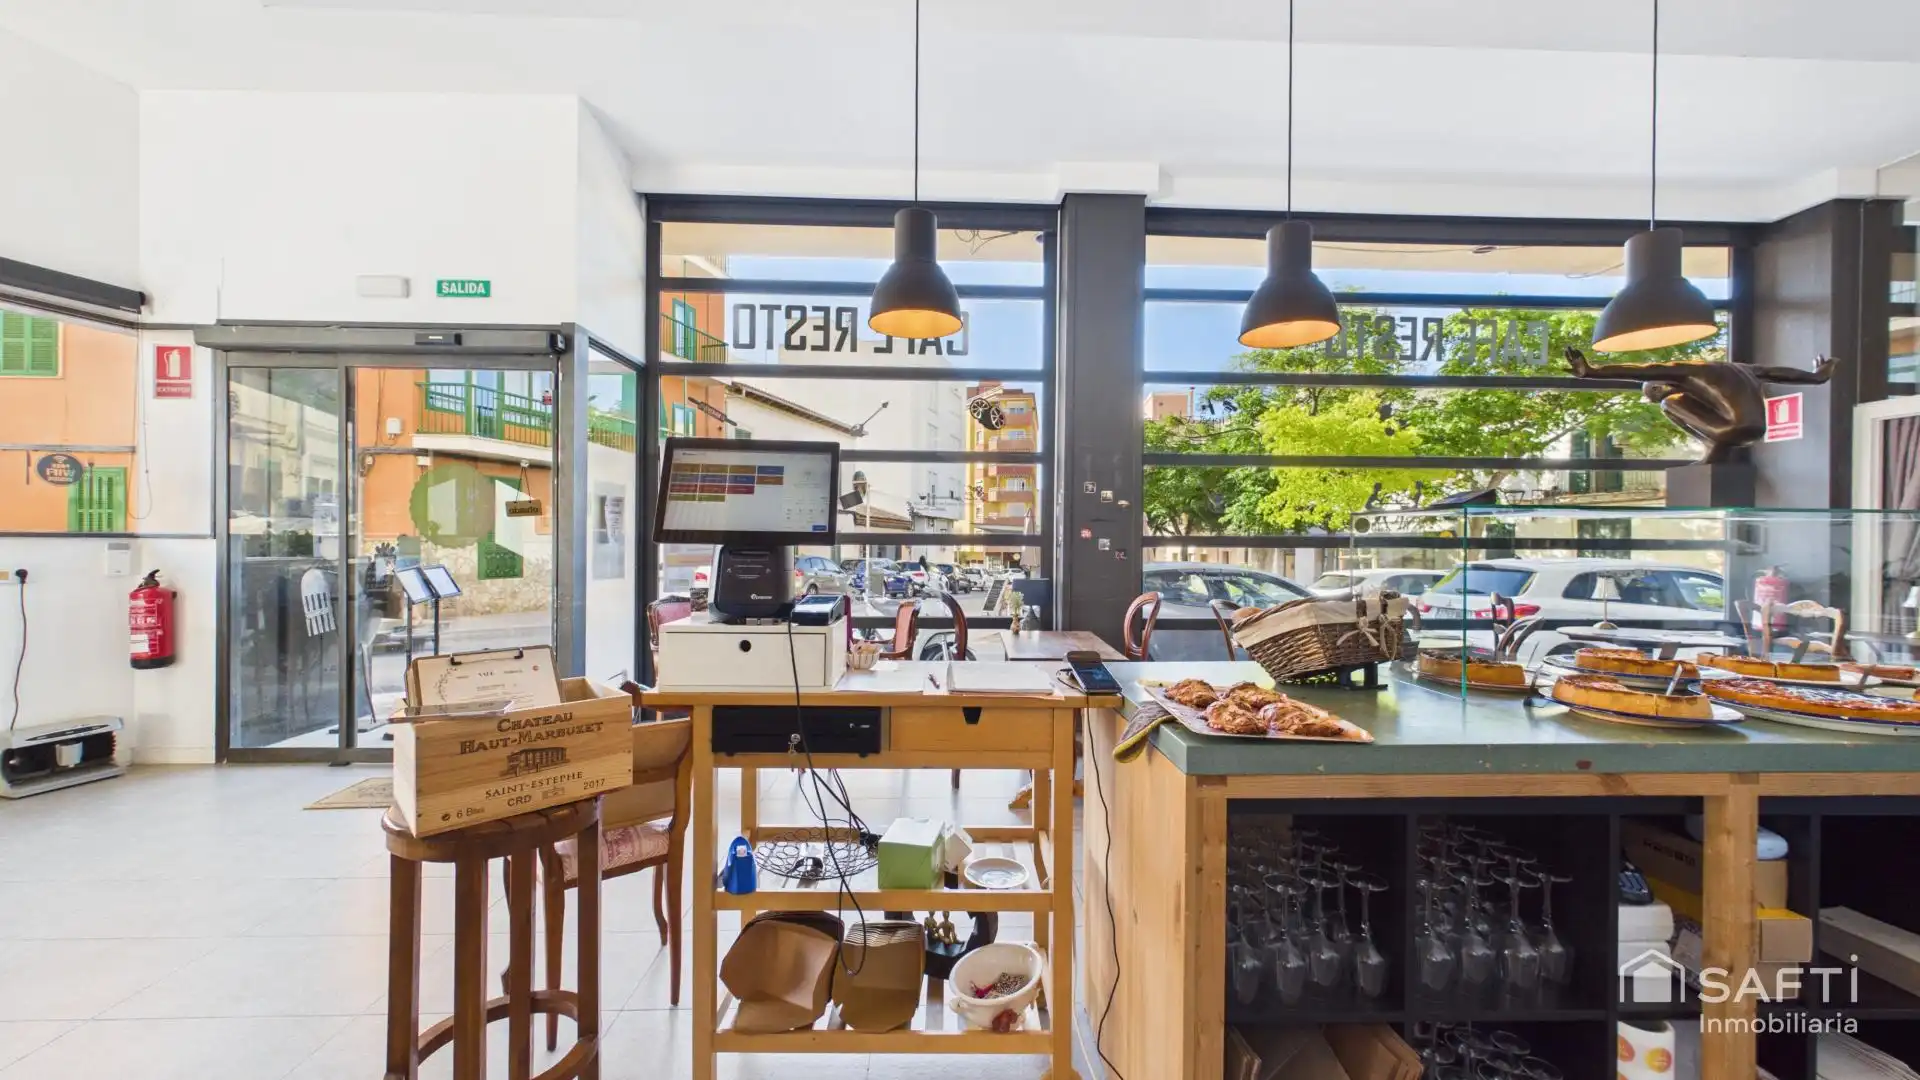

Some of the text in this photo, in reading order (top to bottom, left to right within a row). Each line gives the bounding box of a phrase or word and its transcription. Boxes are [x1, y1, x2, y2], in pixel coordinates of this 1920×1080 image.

[441, 281, 486, 294] SALIDA
[497, 712, 573, 733] CHATEAU
[485, 771, 584, 799] SAINT-ESTEPHE
[583, 778, 606, 791] 2017
[507, 794, 533, 808] CRD
[456, 809, 463, 819] 6
